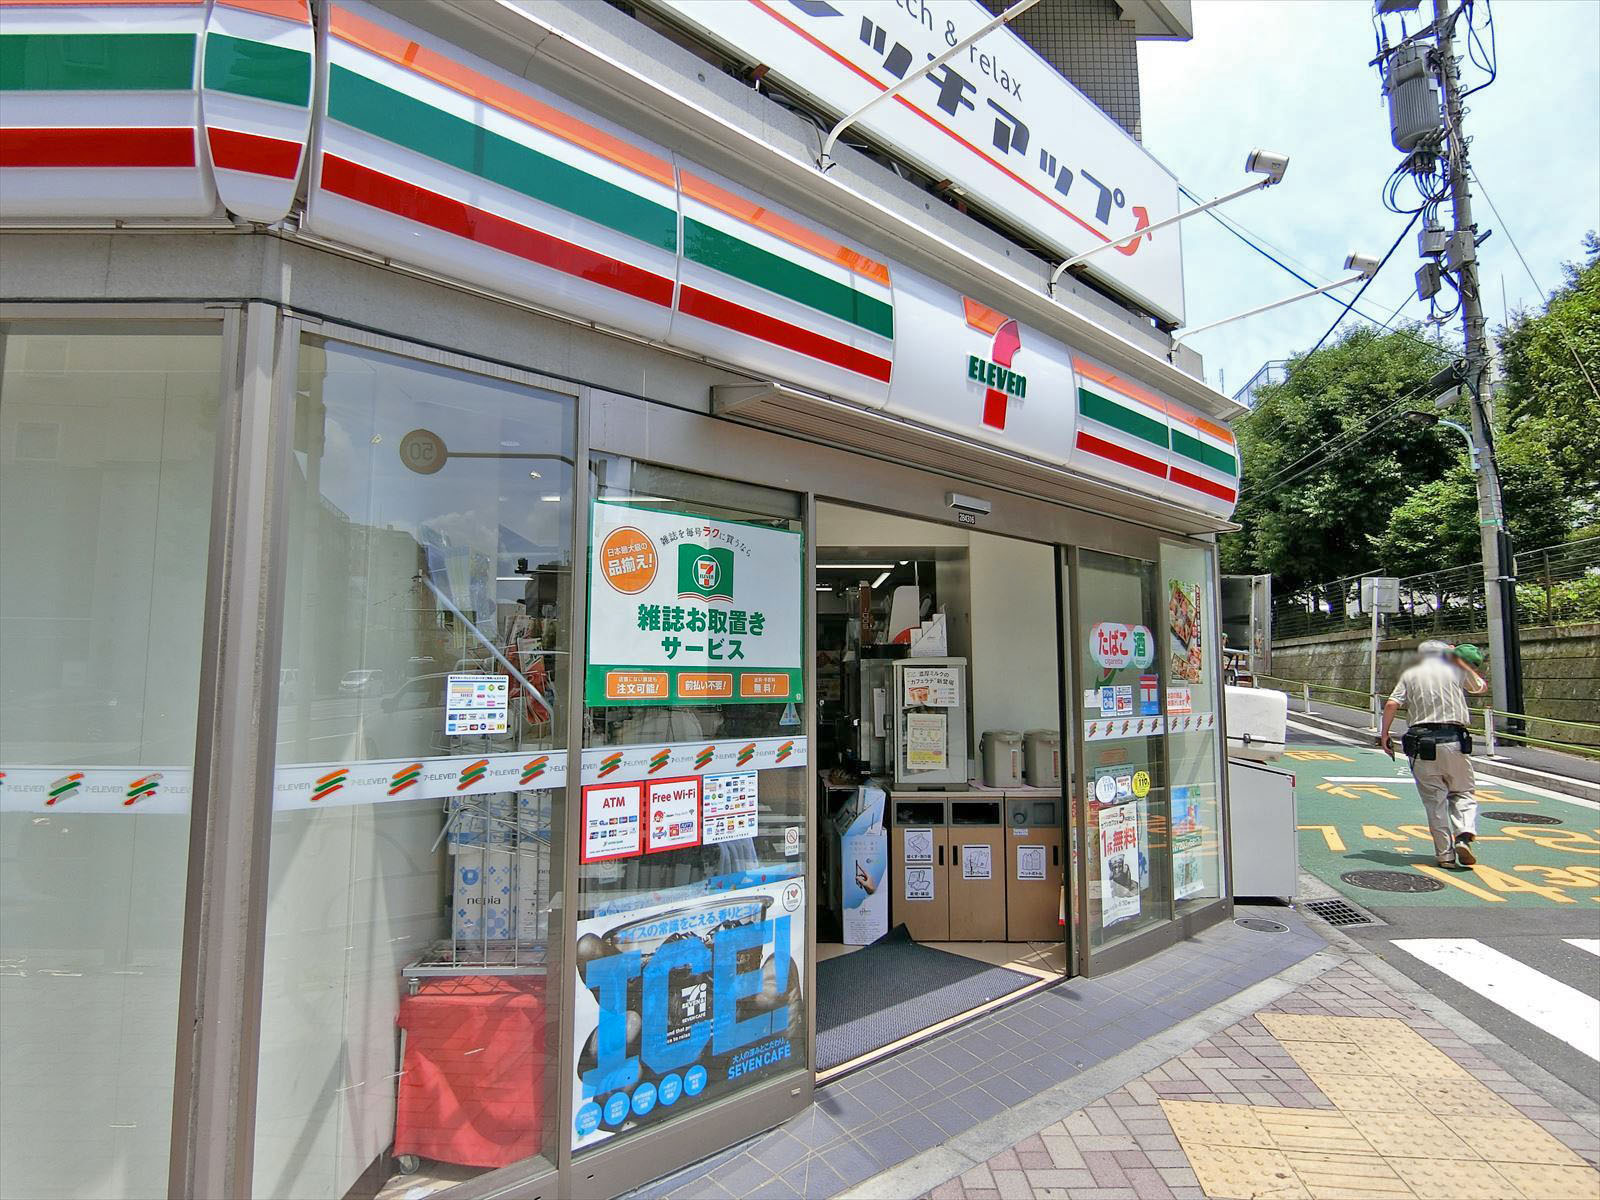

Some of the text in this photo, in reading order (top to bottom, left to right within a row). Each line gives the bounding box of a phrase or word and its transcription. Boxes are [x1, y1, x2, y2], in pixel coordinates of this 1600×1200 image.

[944, 19, 958, 47] &
[970, 44, 1022, 101] relax
[800, 0, 1126, 226] ッチアップ
[637, 604, 766, 637] 雑誌お取置き
[661, 636, 745, 661] サービス
[1098, 628, 1129, 656] たばこ
[1133, 632, 1146, 657] 酒
[602, 796, 625, 809] ATM
[652, 788, 696, 804] Free Wi-Fi
[728, 1054, 762, 1080] SEVEN
